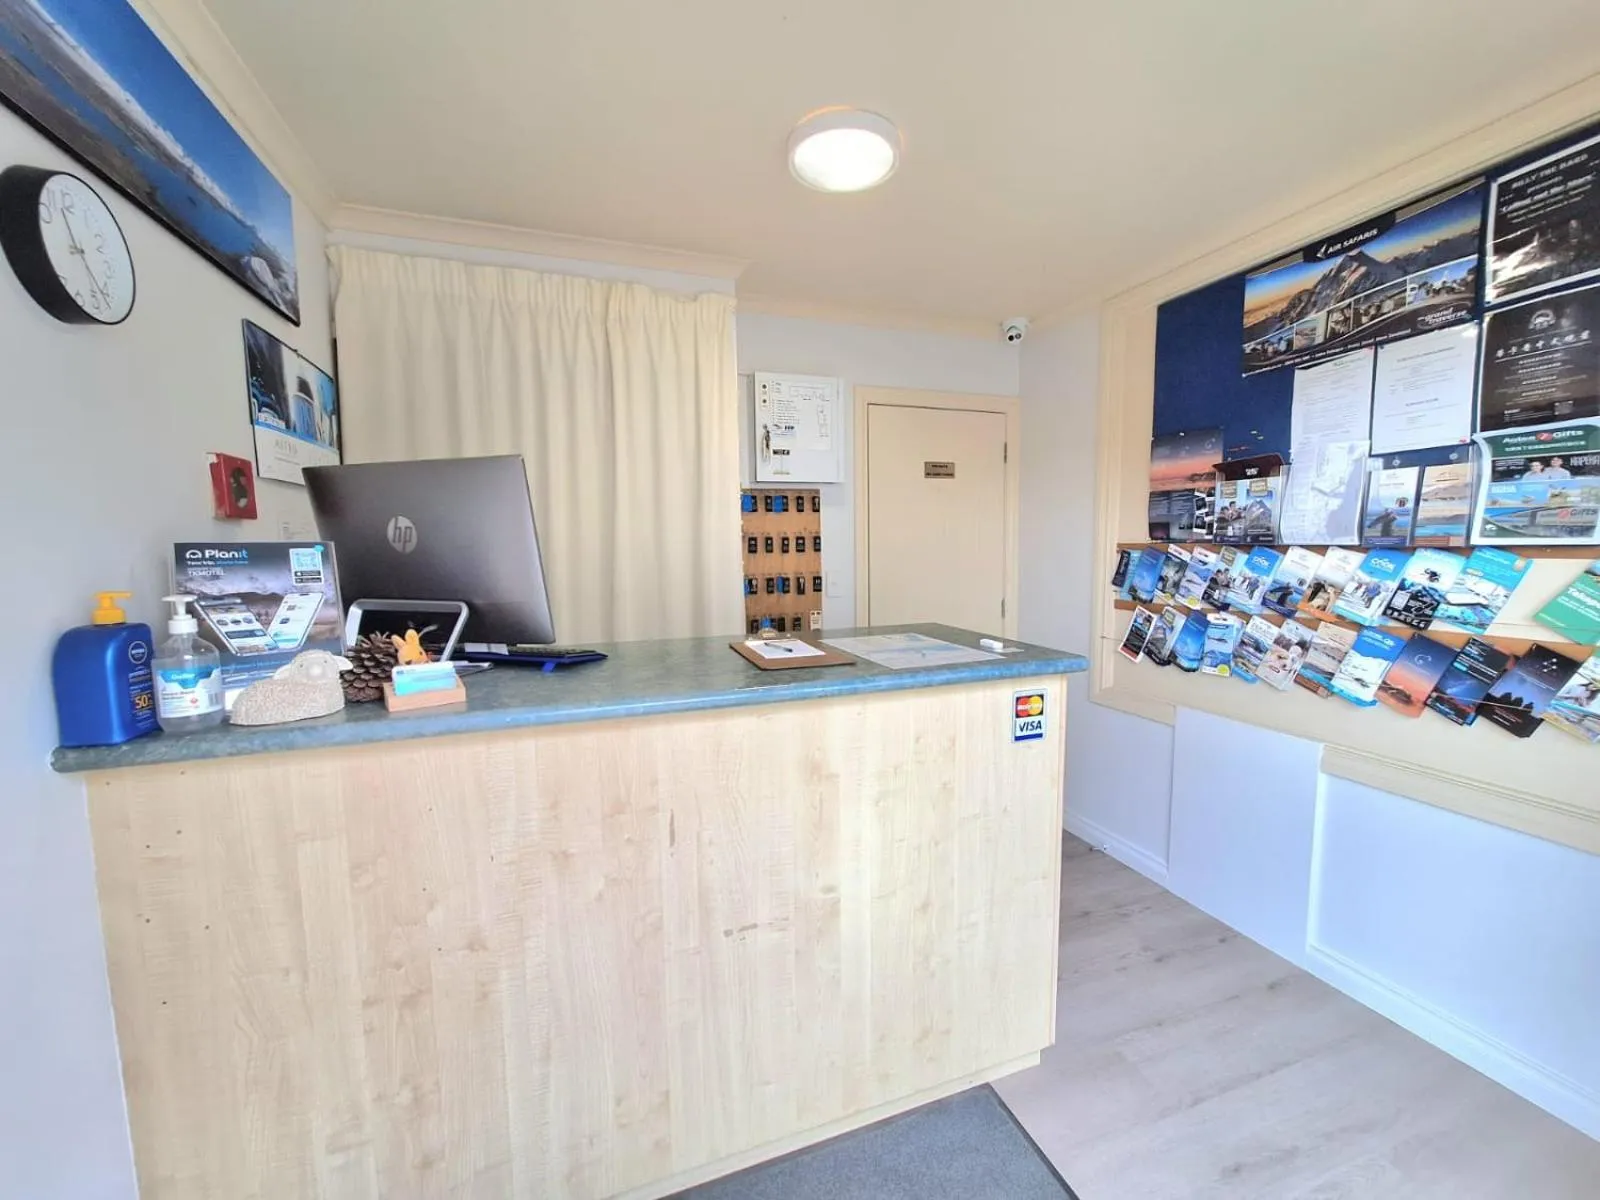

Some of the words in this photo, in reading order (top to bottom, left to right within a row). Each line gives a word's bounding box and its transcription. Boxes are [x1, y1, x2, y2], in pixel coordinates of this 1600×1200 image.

[1327, 242, 1342, 254] AIR
[1342, 227, 1378, 248] SAFARIS
[1552, 430, 1584, 439] Gifts
[392, 517, 413, 553] hp
[204, 548, 249, 559] Planit
[1018, 719, 1043, 733] VISA
